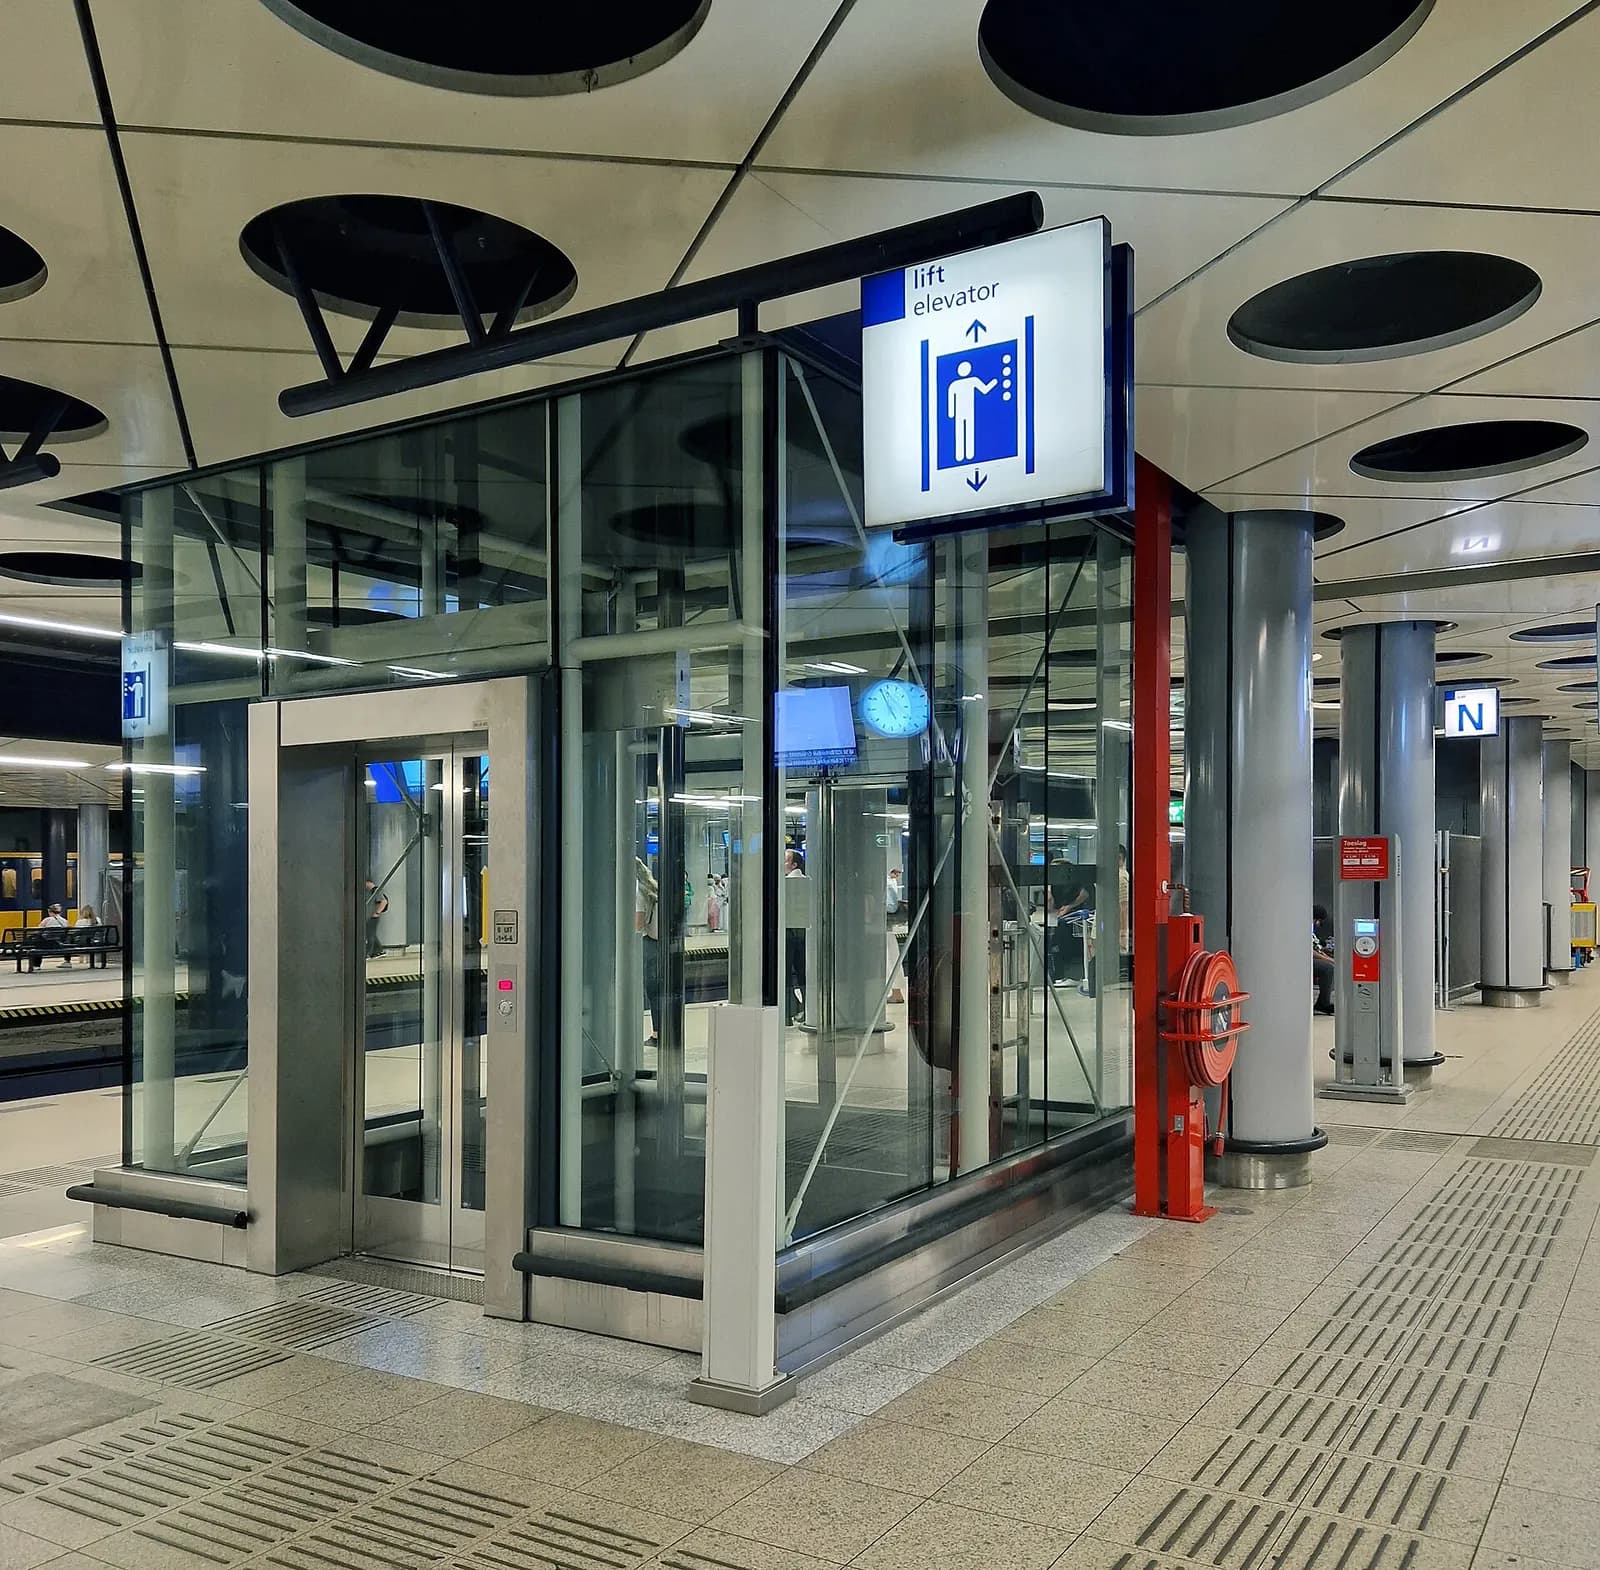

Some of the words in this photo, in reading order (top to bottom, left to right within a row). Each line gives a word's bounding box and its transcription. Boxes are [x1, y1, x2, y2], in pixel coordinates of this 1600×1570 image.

[914, 265, 945, 289] lift
[914, 282, 1000, 316] elevator
[1458, 703, 1483, 731] N
